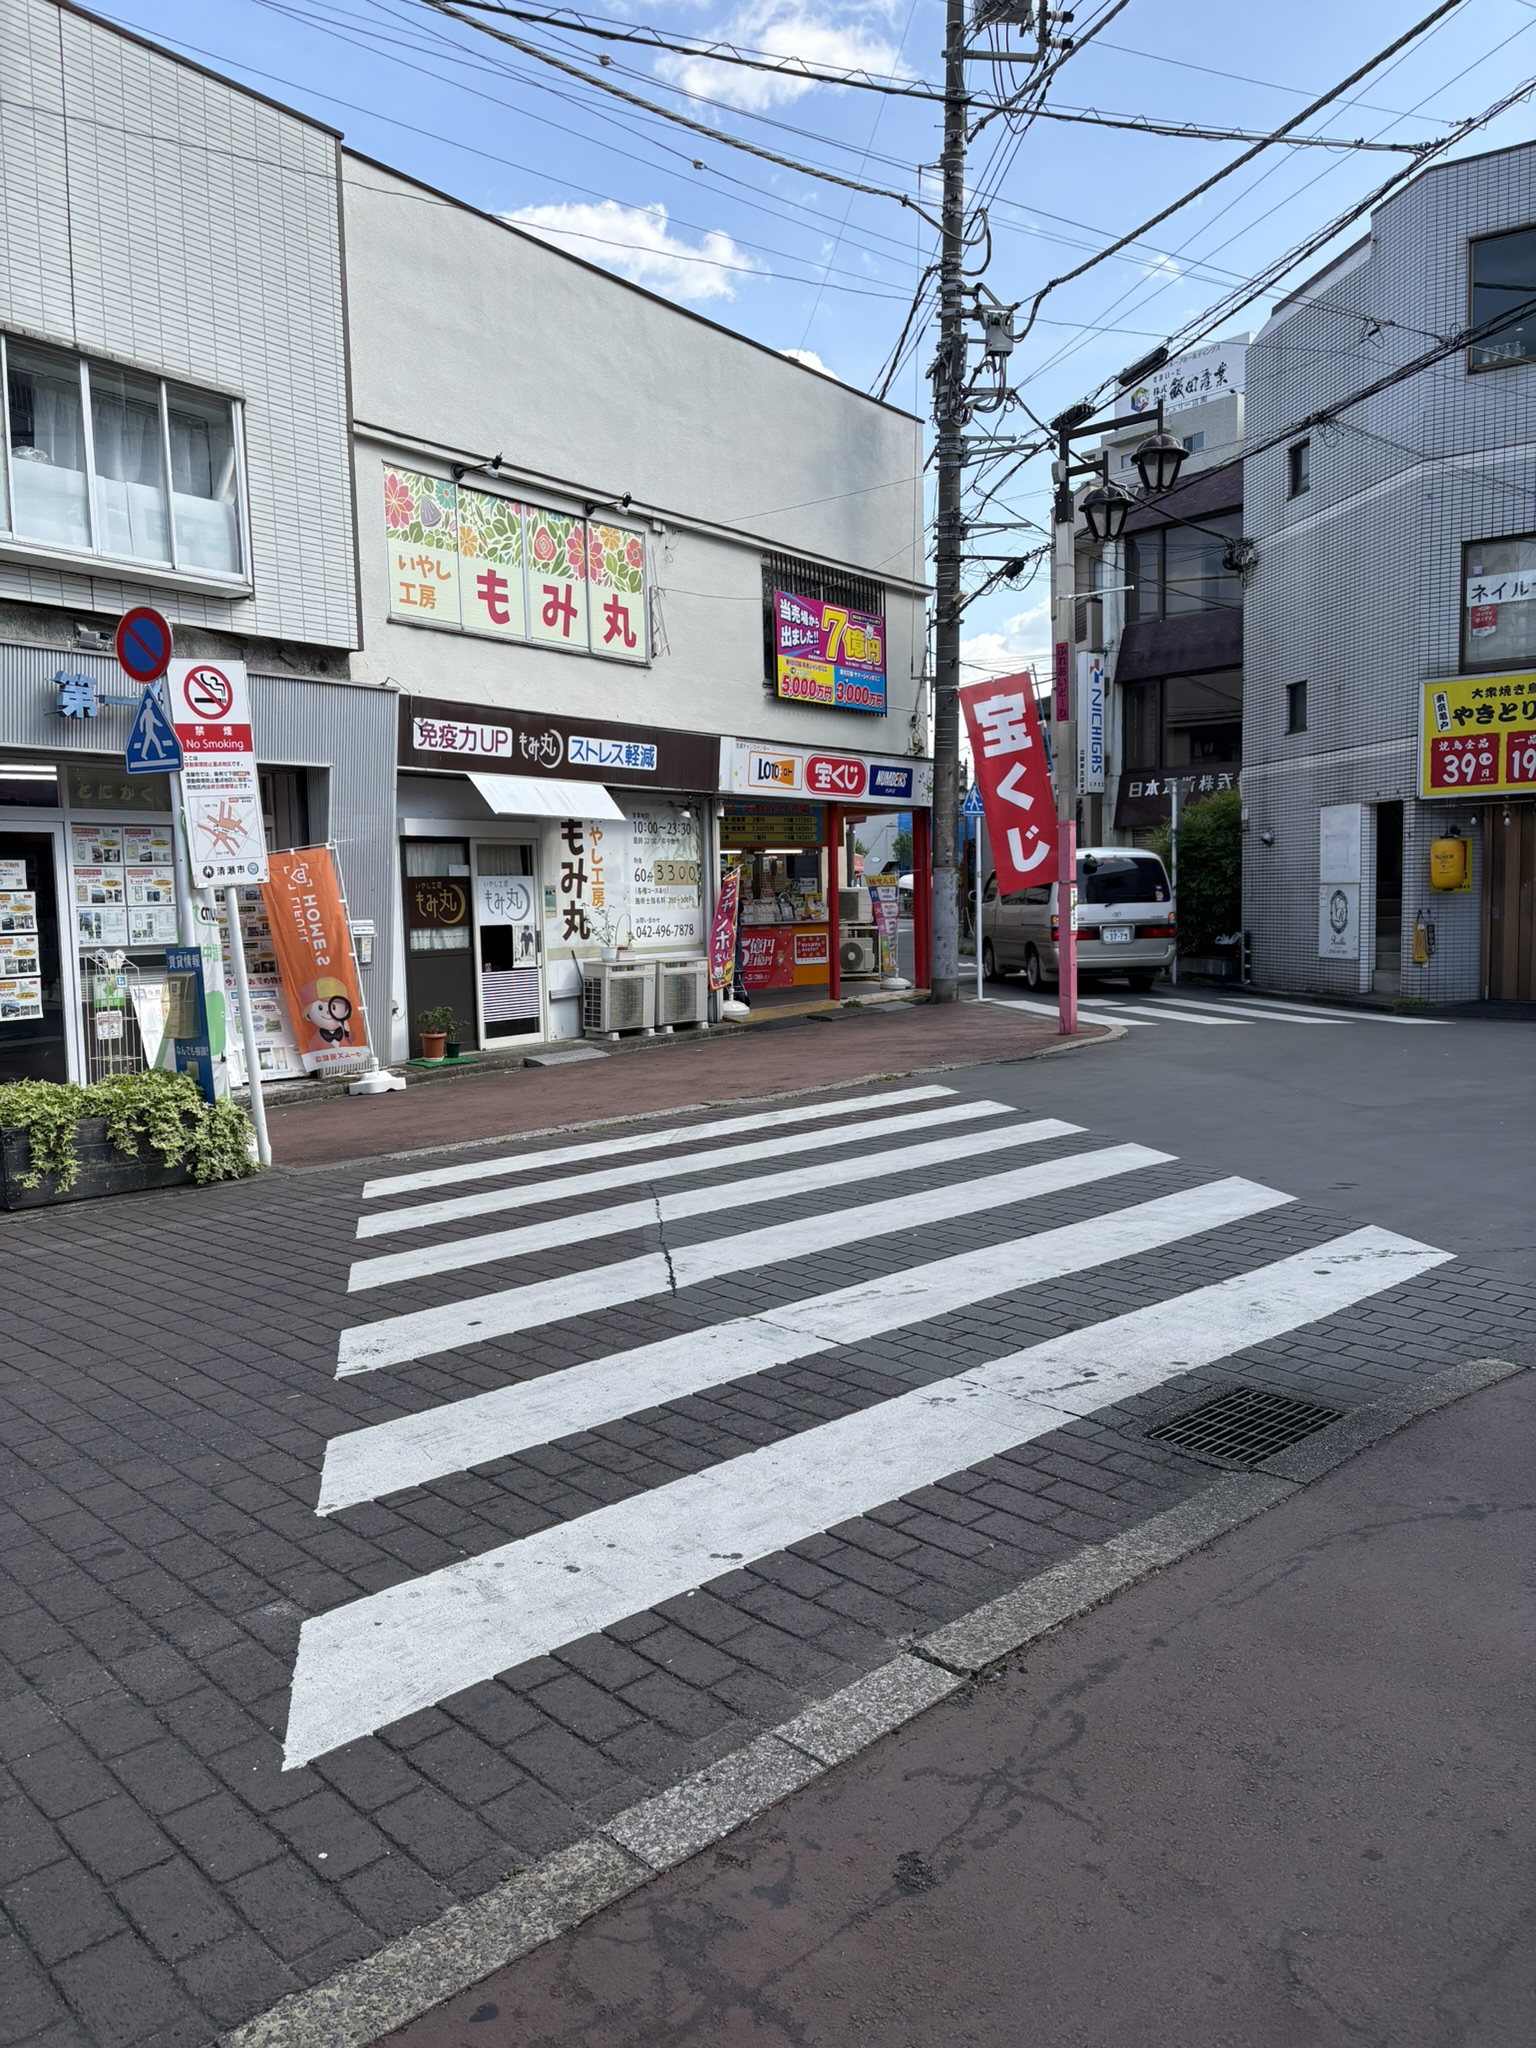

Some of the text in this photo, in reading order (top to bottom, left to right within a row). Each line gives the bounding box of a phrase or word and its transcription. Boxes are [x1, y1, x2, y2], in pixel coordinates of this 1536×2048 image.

[1169, 361, 1228, 400] 飯田産業
[398, 554, 451, 581] いやし
[399, 581, 436, 610] 工房
[1471, 581, 1536, 603] ネイル
[476, 568, 637, 648] もみ丸
[780, 598, 820, 629] 当売場から
[821, 605, 882, 666] 7億円
[55, 670, 163, 720] 第一
[781, 674, 833, 702] 5,000万円
[836, 682, 883, 708] 3,000万円
[186, 739, 244, 751] No Smoking
[418, 721, 508, 753] 免疫力UP
[1091, 688, 1102, 774] NICHIGAS
[1439, 738, 1489, 751] 焼鳥全品
[519, 731, 556, 761] もみ丸
[570, 739, 655, 768] ストレス軽減
[758, 758, 780, 780] LOTO
[815, 762, 859, 790] 宝くじ
[875, 769, 908, 789] NUMBERS
[973, 692, 1050, 873] 宝くじ
[78, 783, 149, 800] とにかく
[1128, 773, 1242, 798] 日本株式
[217, 865, 245, 876] 清瀬市
[589, 820, 605, 908] やし工房
[634, 864, 696, 883] 60分 3300
[560, 819, 591, 941] もみ丸
[415, 889, 457, 919] もみ丸
[485, 888, 523, 916] もみ丸
[715, 880, 736, 950] ジャンボ
[636, 923, 694, 939] 042-496-7878
[168, 954, 200, 969] 賃貸情報
